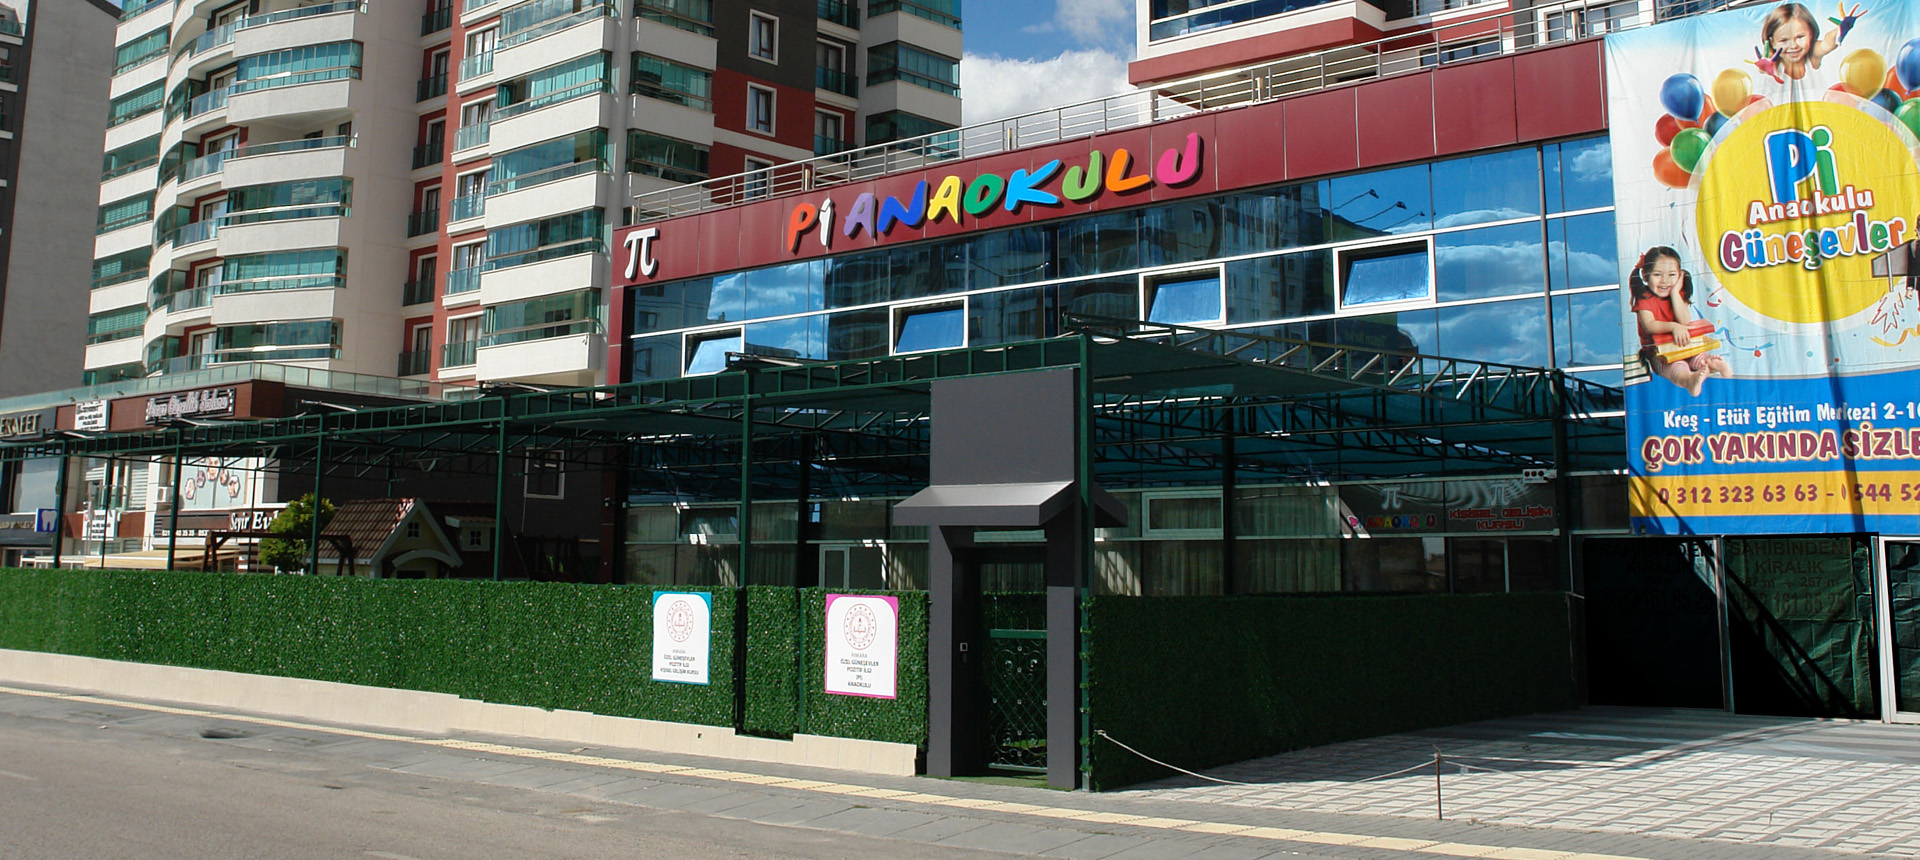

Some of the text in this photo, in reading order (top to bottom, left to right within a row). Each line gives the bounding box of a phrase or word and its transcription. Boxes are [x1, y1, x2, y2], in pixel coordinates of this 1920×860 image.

[843, 131, 1203, 239] ANAOKULU
[1764, 126, 1840, 203] Pi
[1748, 185, 1875, 226] Anaokulu
[1719, 210, 1907, 272] Güneşevler
[1663, 410, 1698, 431] Kreş
[1717, 406, 1750, 427] Etüt
[1756, 404, 1811, 429] Eğitim
[1817, 402, 1877, 422] Merkezi
[1642, 434, 1703, 472] ÇOK
[1708, 430, 1839, 463] YAKINDA
[1676, 486, 1712, 504] 312
[1719, 485, 1754, 503] 323
[1762, 484, 1786, 503] 63
[1794, 483, 1818, 502] 63
[1854, 483, 1892, 502] 544
